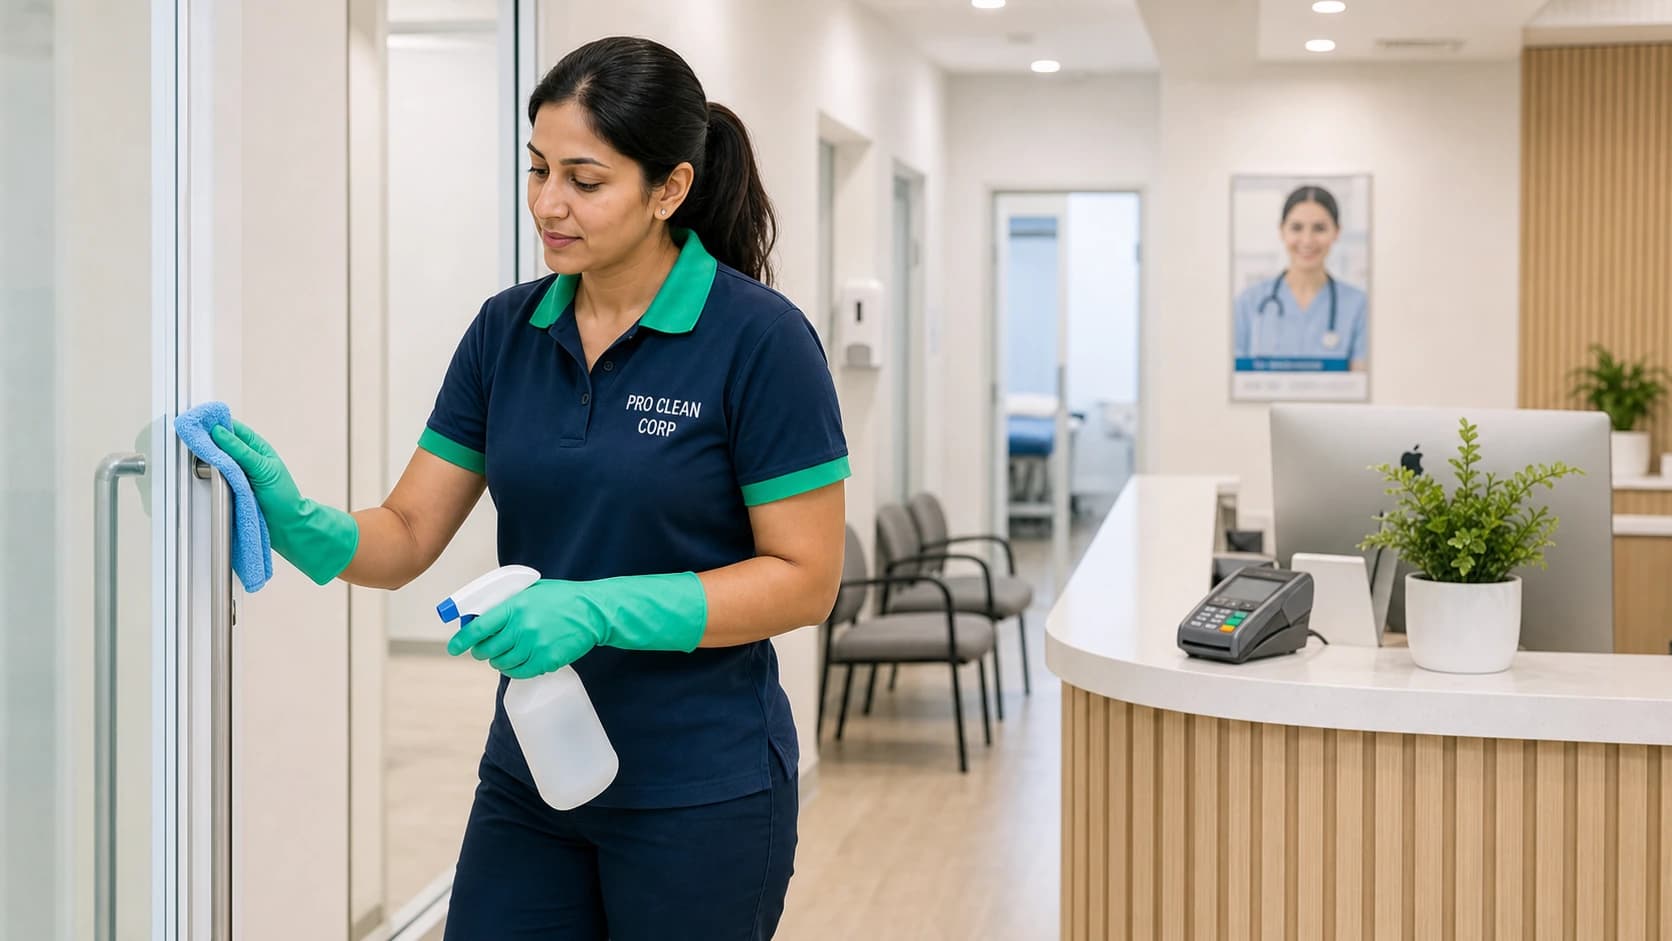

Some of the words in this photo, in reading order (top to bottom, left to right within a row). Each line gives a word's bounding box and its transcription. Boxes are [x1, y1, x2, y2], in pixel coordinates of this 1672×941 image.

[626, 394, 654, 412] PRO
[656, 397, 702, 418] CLEAN
[638, 418, 676, 437] CORP
